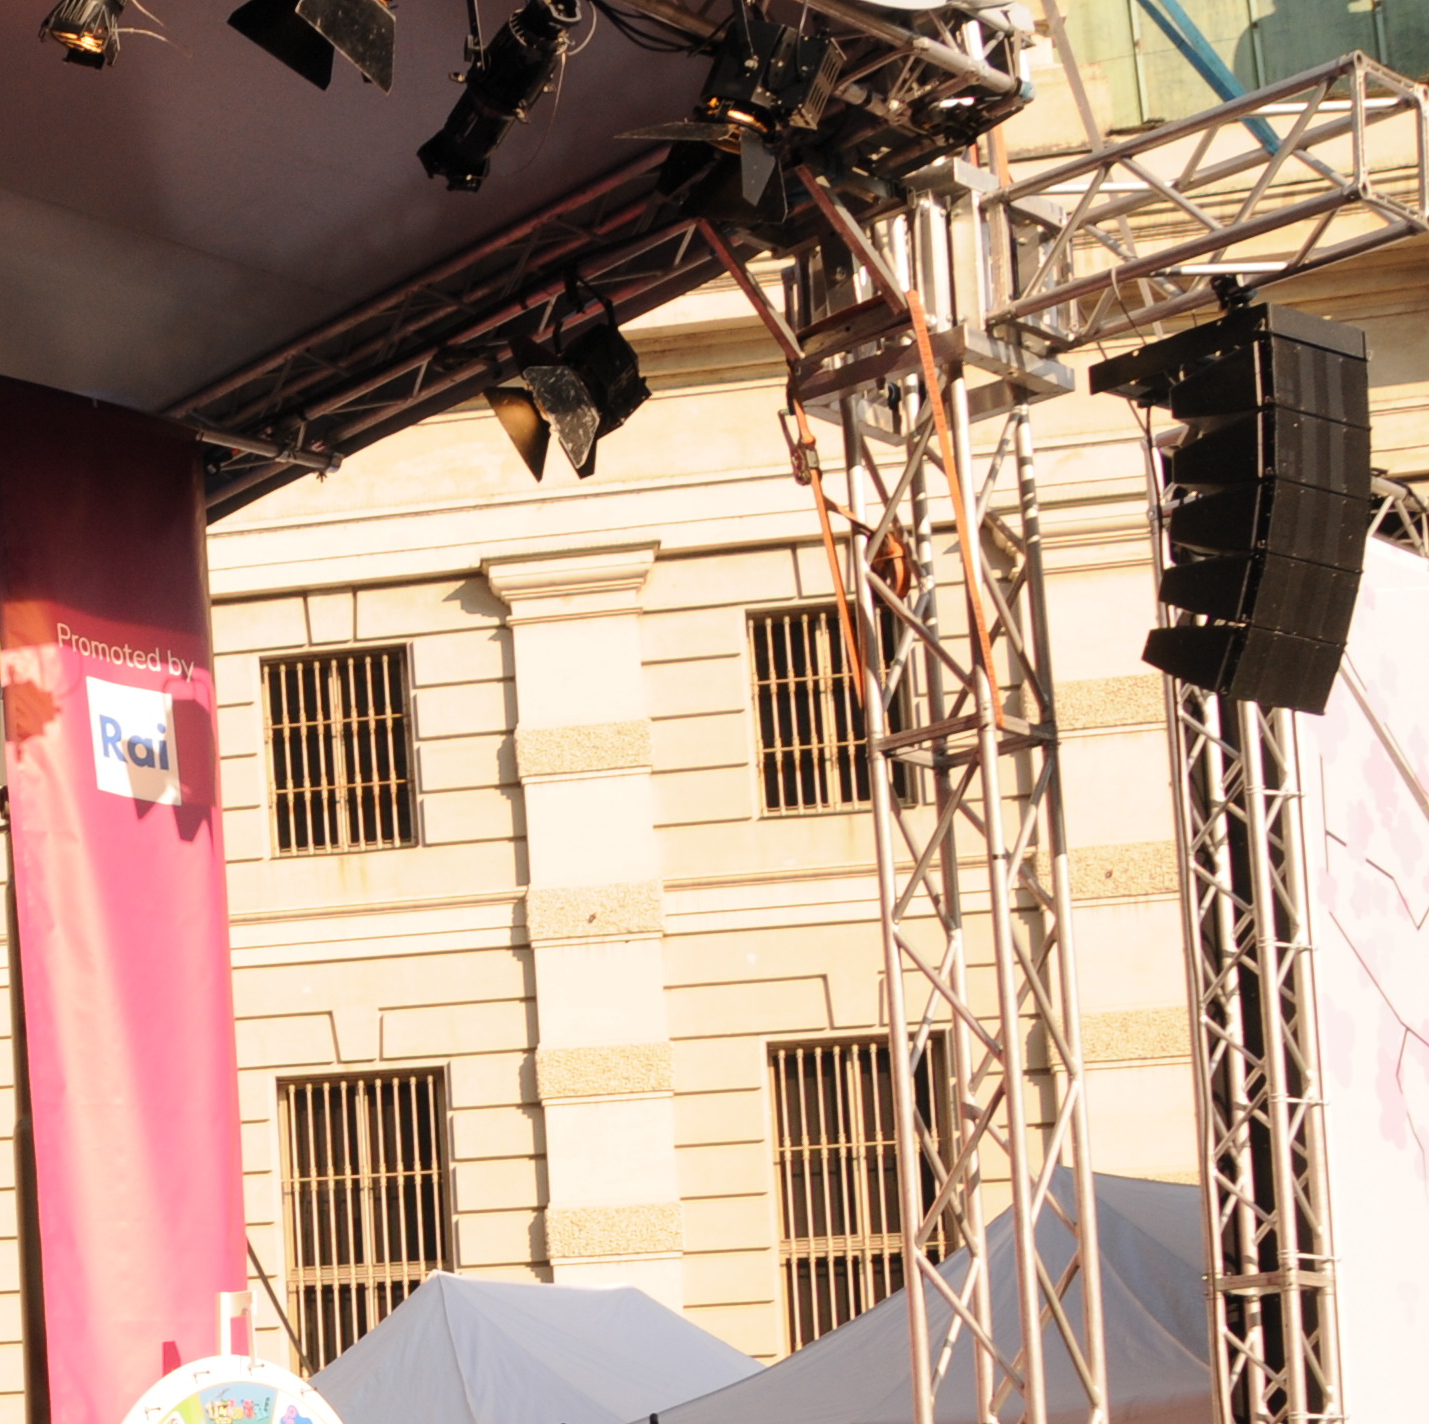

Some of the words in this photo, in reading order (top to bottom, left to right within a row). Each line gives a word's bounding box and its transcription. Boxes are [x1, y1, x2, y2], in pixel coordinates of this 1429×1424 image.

[57, 622, 162, 672] Promoted
[167, 650, 195, 683] by
[99, 714, 170, 770] Rai
